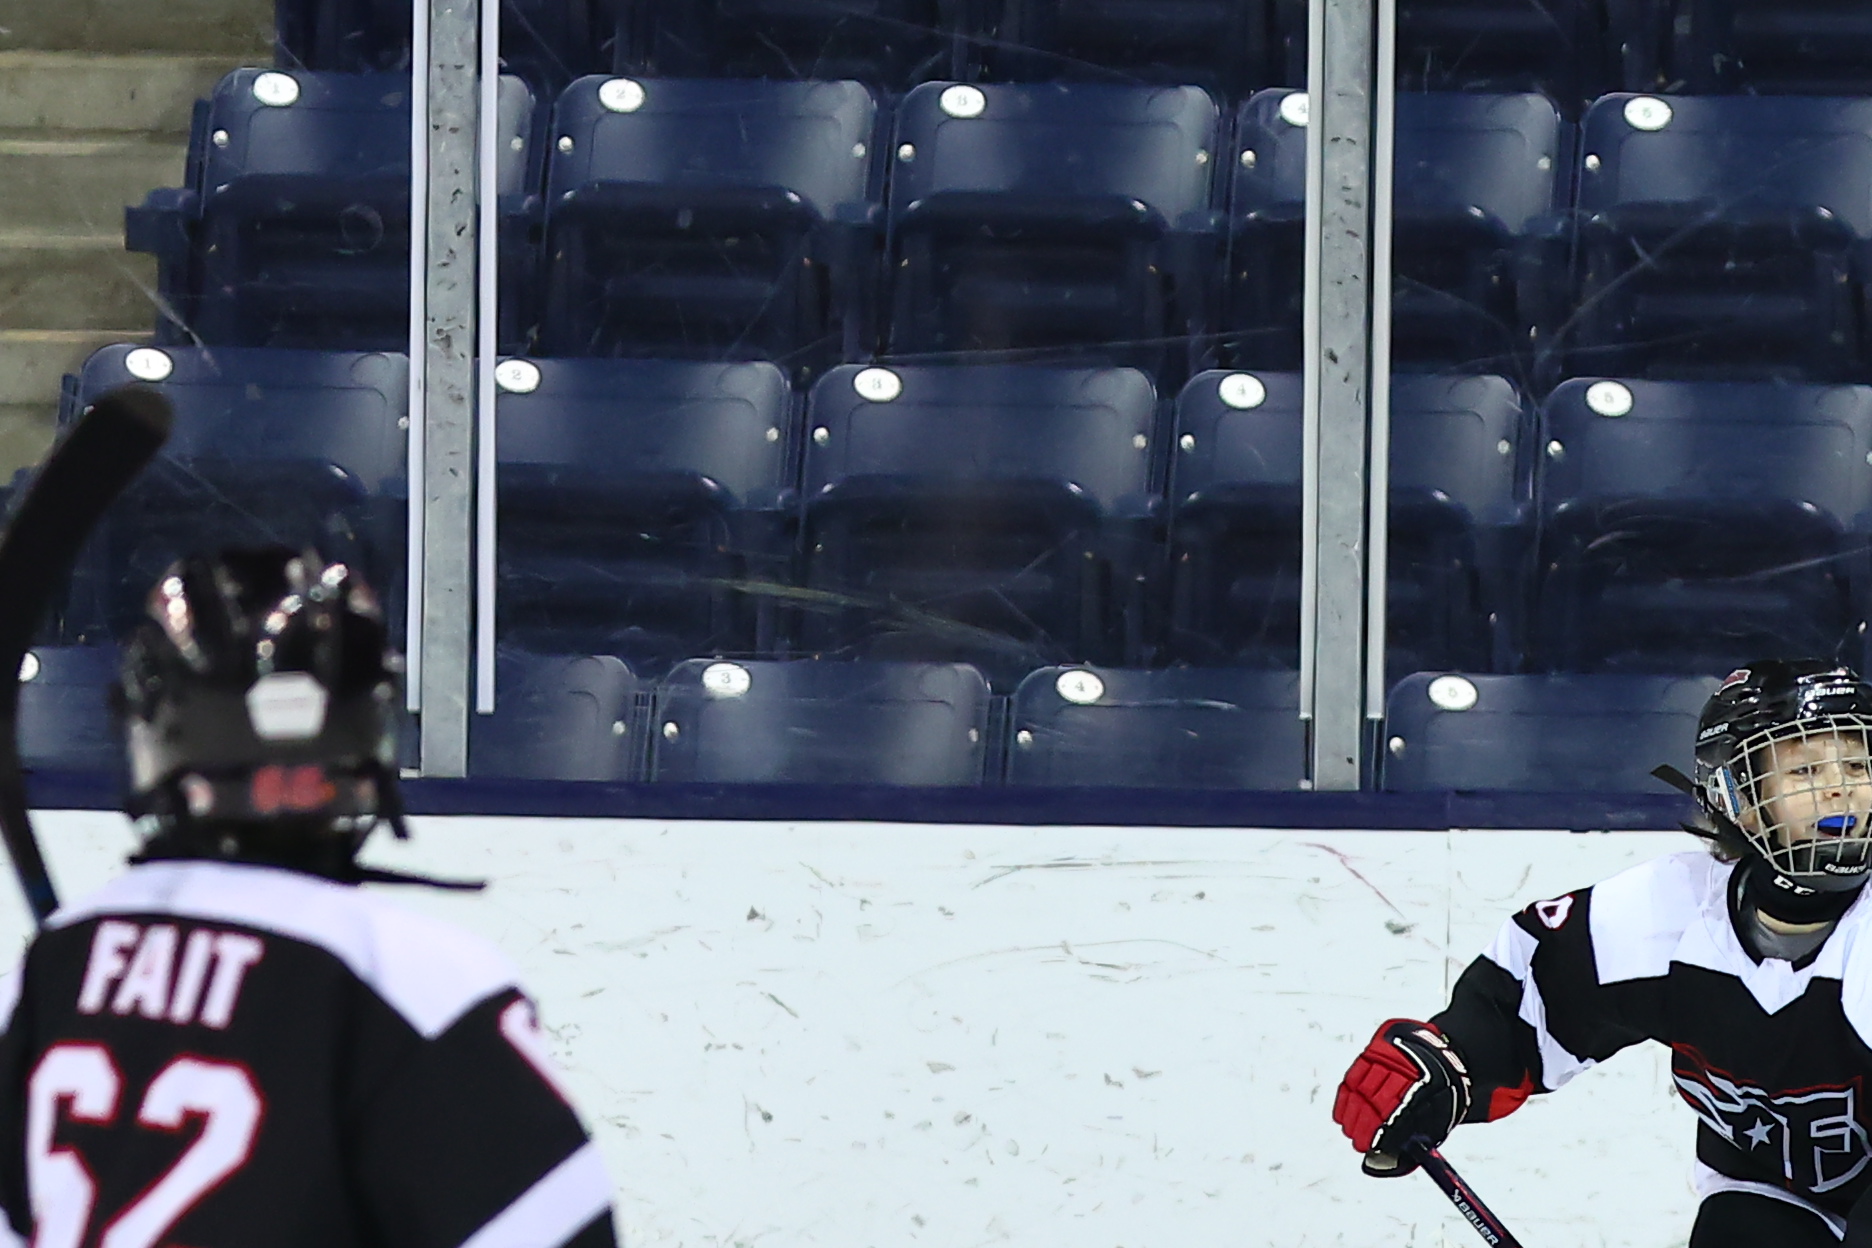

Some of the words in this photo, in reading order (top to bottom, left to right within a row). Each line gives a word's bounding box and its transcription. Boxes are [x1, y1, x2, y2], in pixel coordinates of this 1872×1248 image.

[1804, 686, 1855, 701] BAUER
[1700, 722, 1730, 740] BAUER
[76, 918, 266, 1030] FAIT
[1457, 1201, 1500, 1247] BAUER
